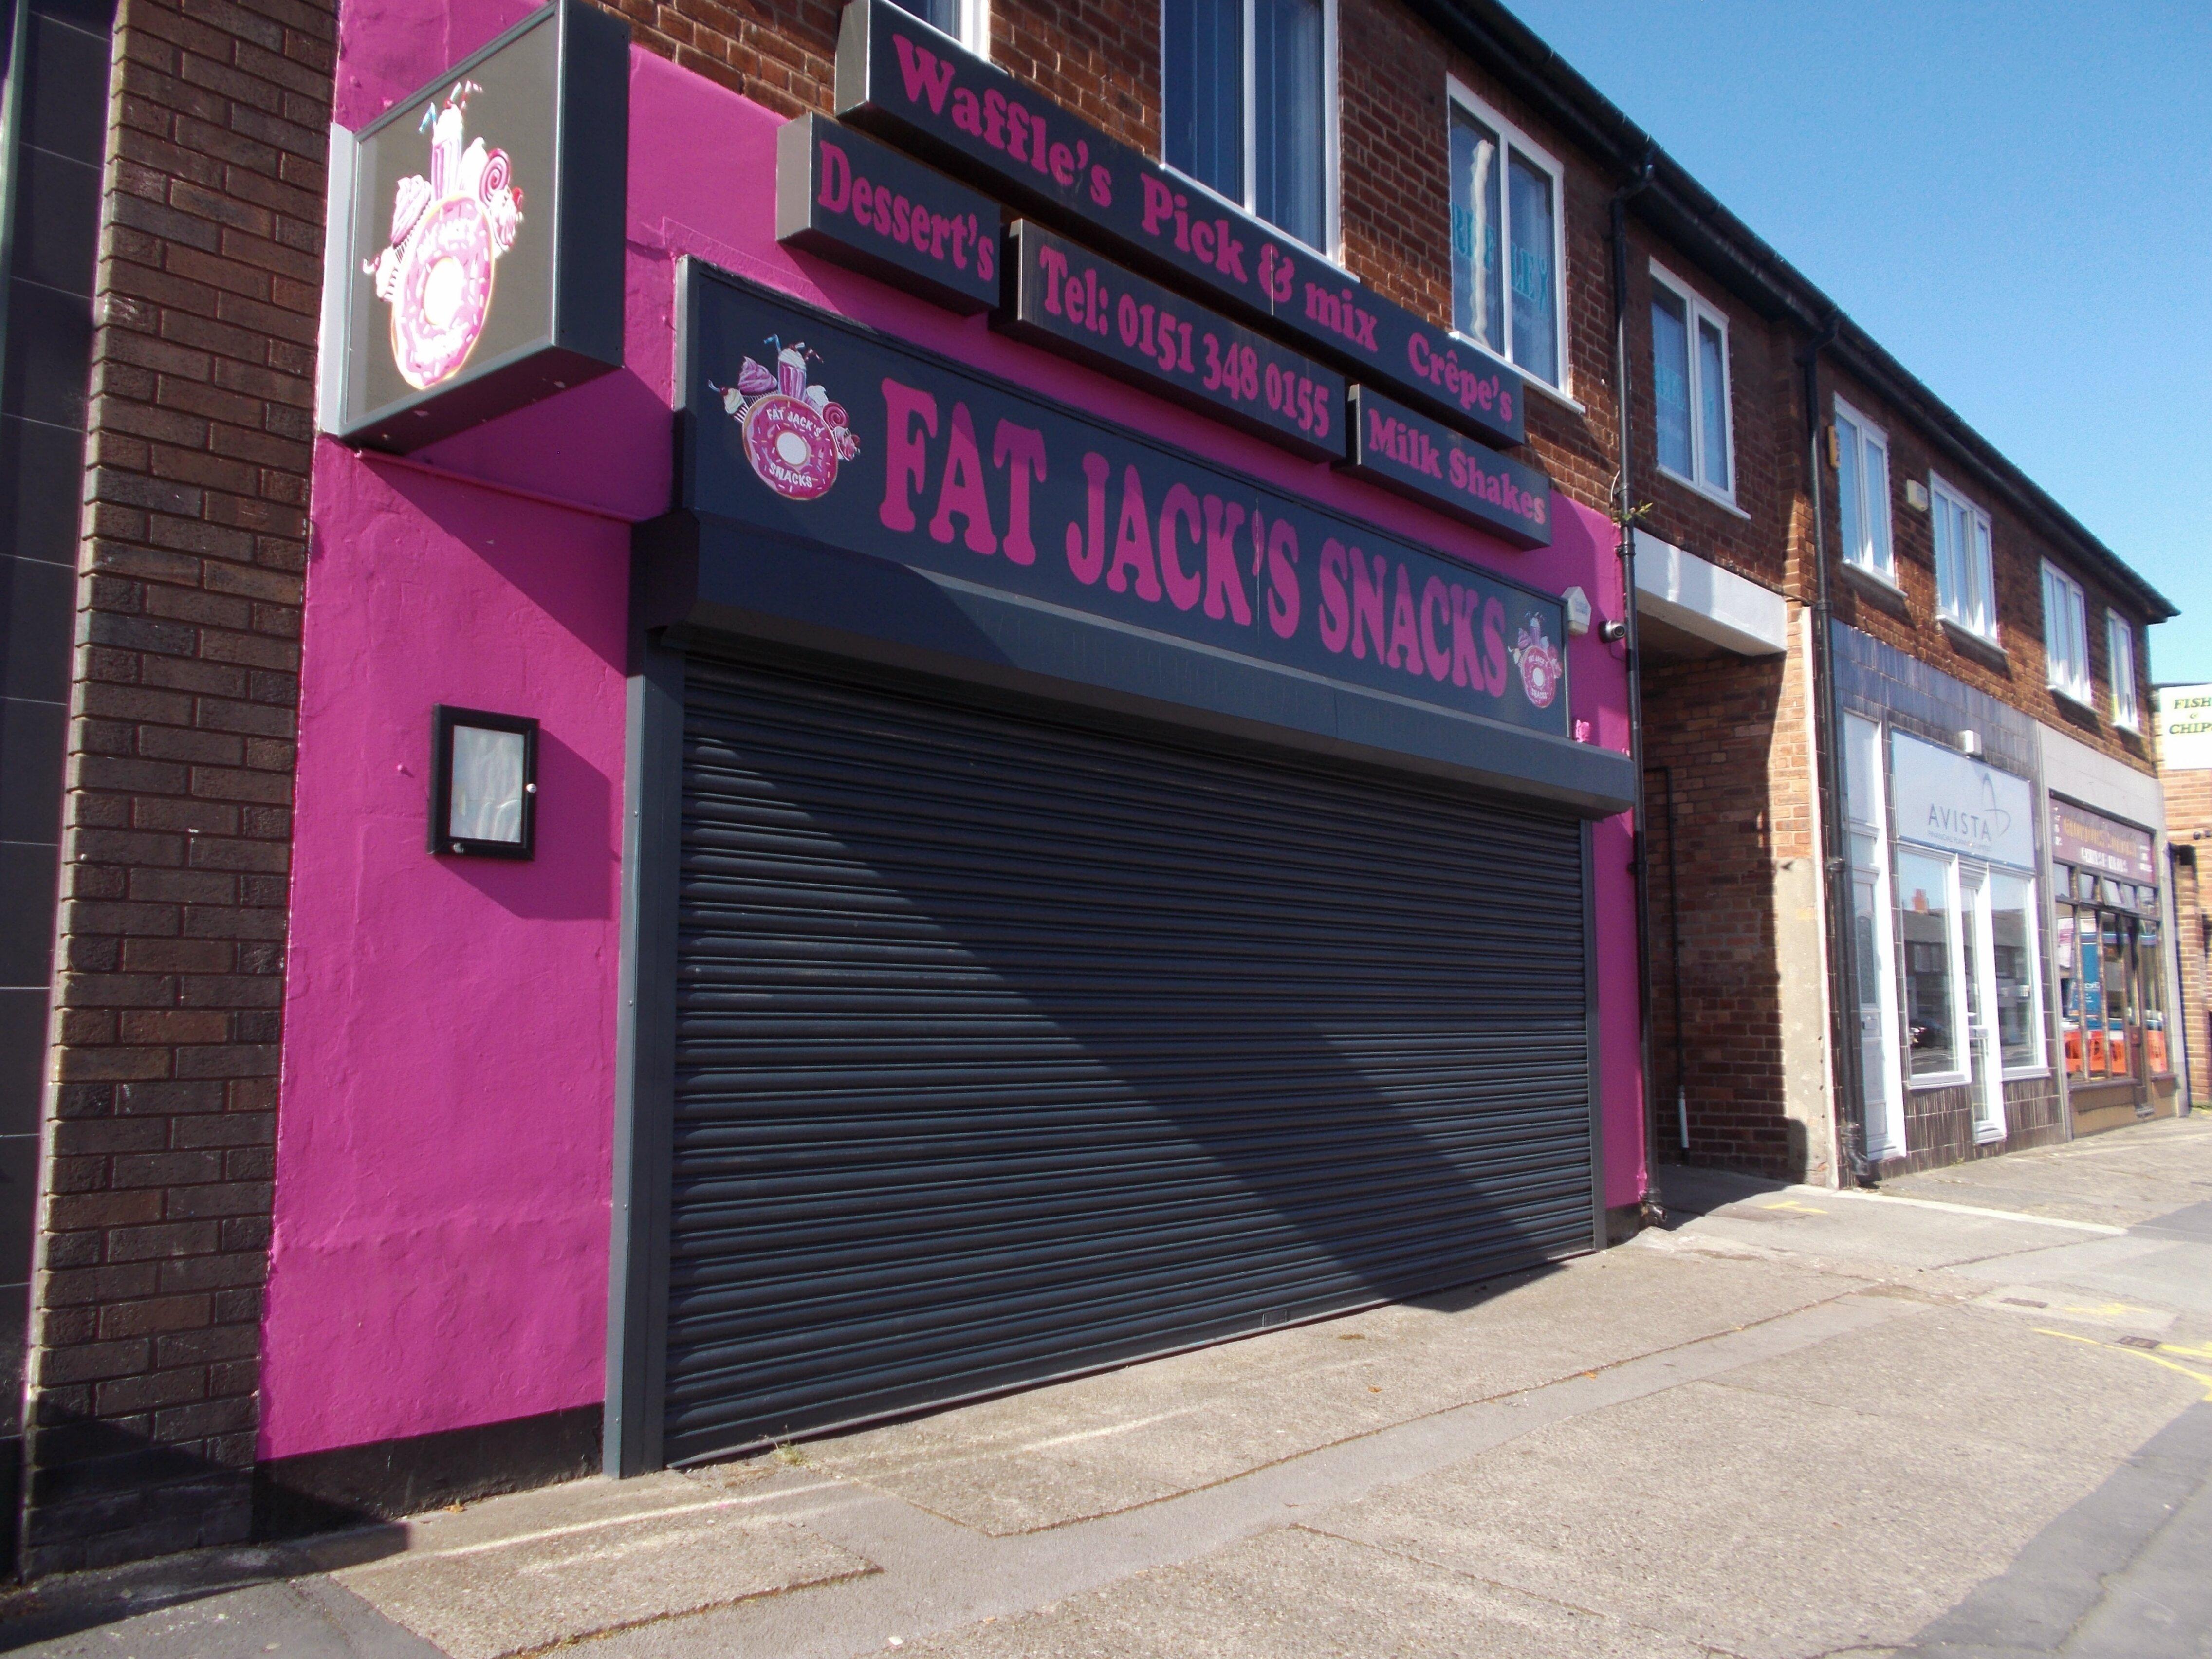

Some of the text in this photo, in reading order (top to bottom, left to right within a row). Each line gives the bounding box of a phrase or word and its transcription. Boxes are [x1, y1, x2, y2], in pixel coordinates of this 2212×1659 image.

[818, 140, 995, 282] Dessert's
[892, 33, 1513, 423] Waffle's Pick & mix Crêpe's
[1039, 245, 1330, 439] Tel: 0151 348 0155
[766, 408, 785, 421] FAT
[769, 464, 812, 488] SNACKS
[1368, 408, 1546, 525] Milk Shakes
[879, 377, 1507, 698] FAT JACK'S SNACKS
[2169, 722, 2212, 735] CHIP
[2174, 697, 2212, 709] FISH
[1928, 803, 1991, 842] AVISTA
